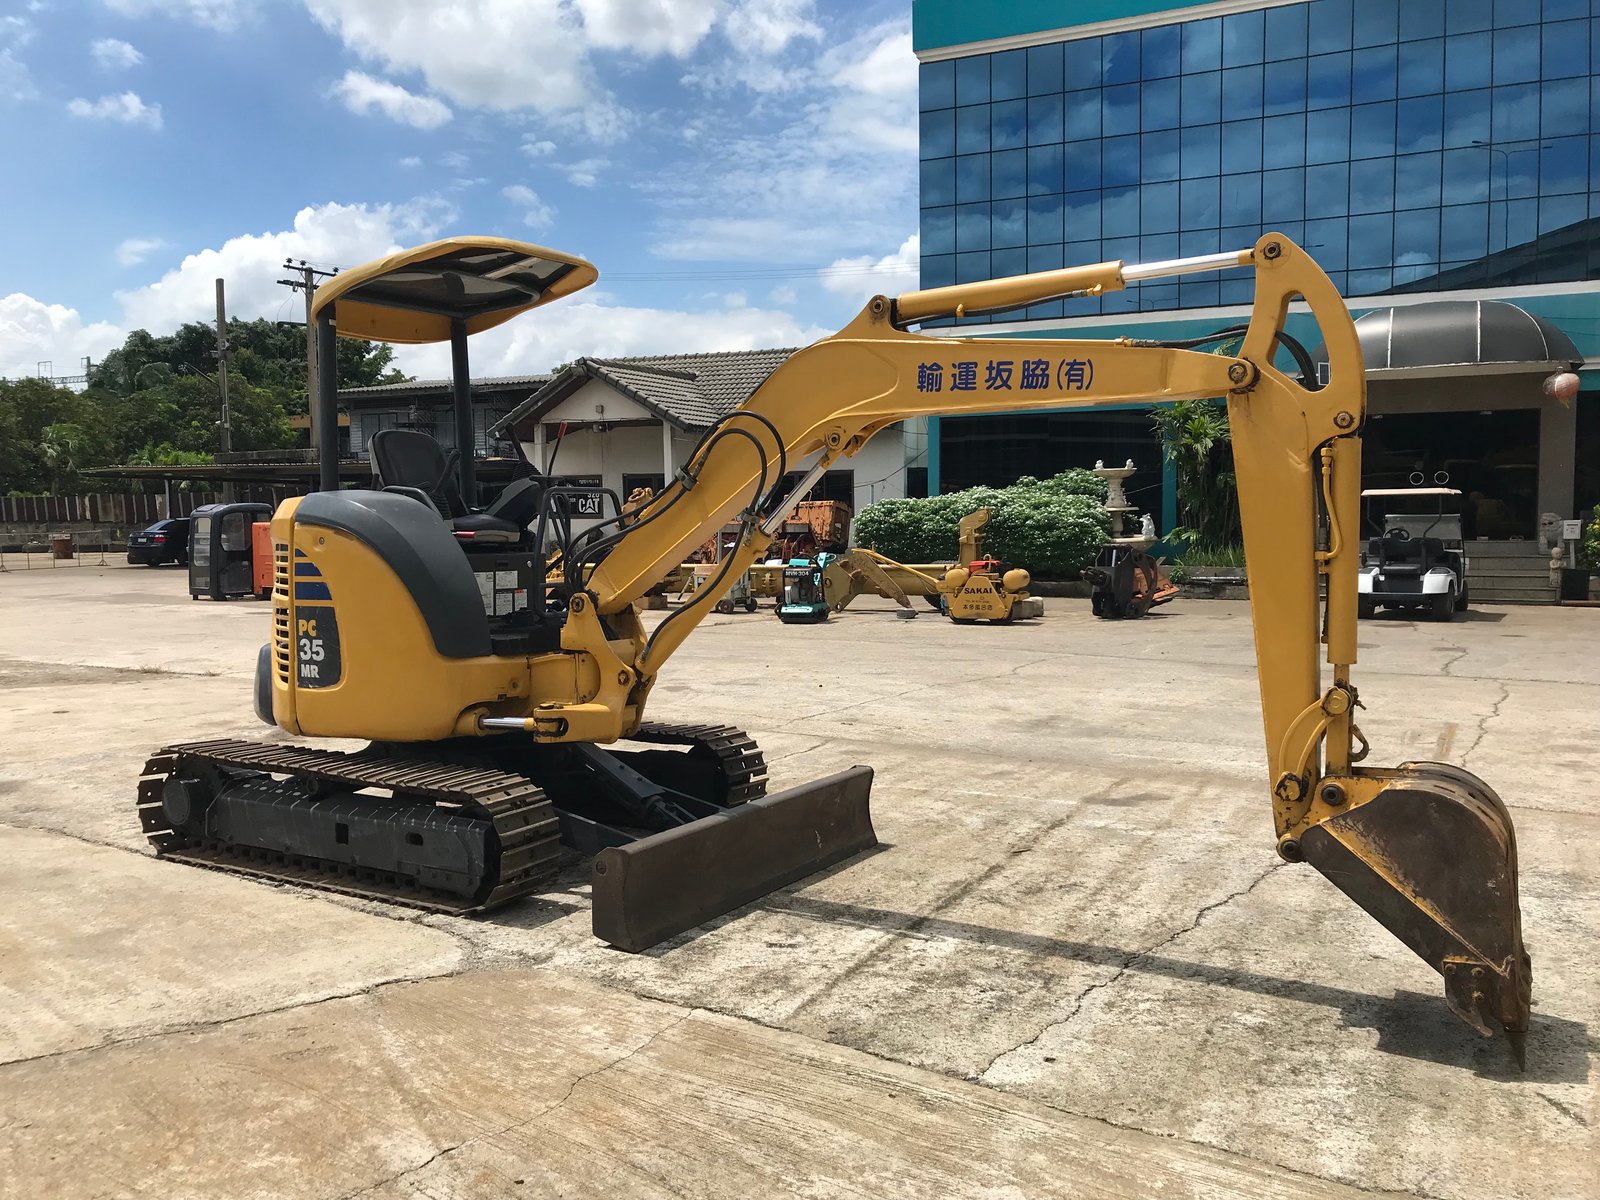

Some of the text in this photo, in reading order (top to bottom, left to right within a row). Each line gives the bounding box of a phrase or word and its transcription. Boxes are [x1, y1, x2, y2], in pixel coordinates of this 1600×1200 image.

[578, 498, 600, 514] CAT
[964, 587, 992, 595] SAKAI
[298, 619, 317, 637] PC
[299, 638, 325, 662] 35
[300, 664, 320, 679] MR
